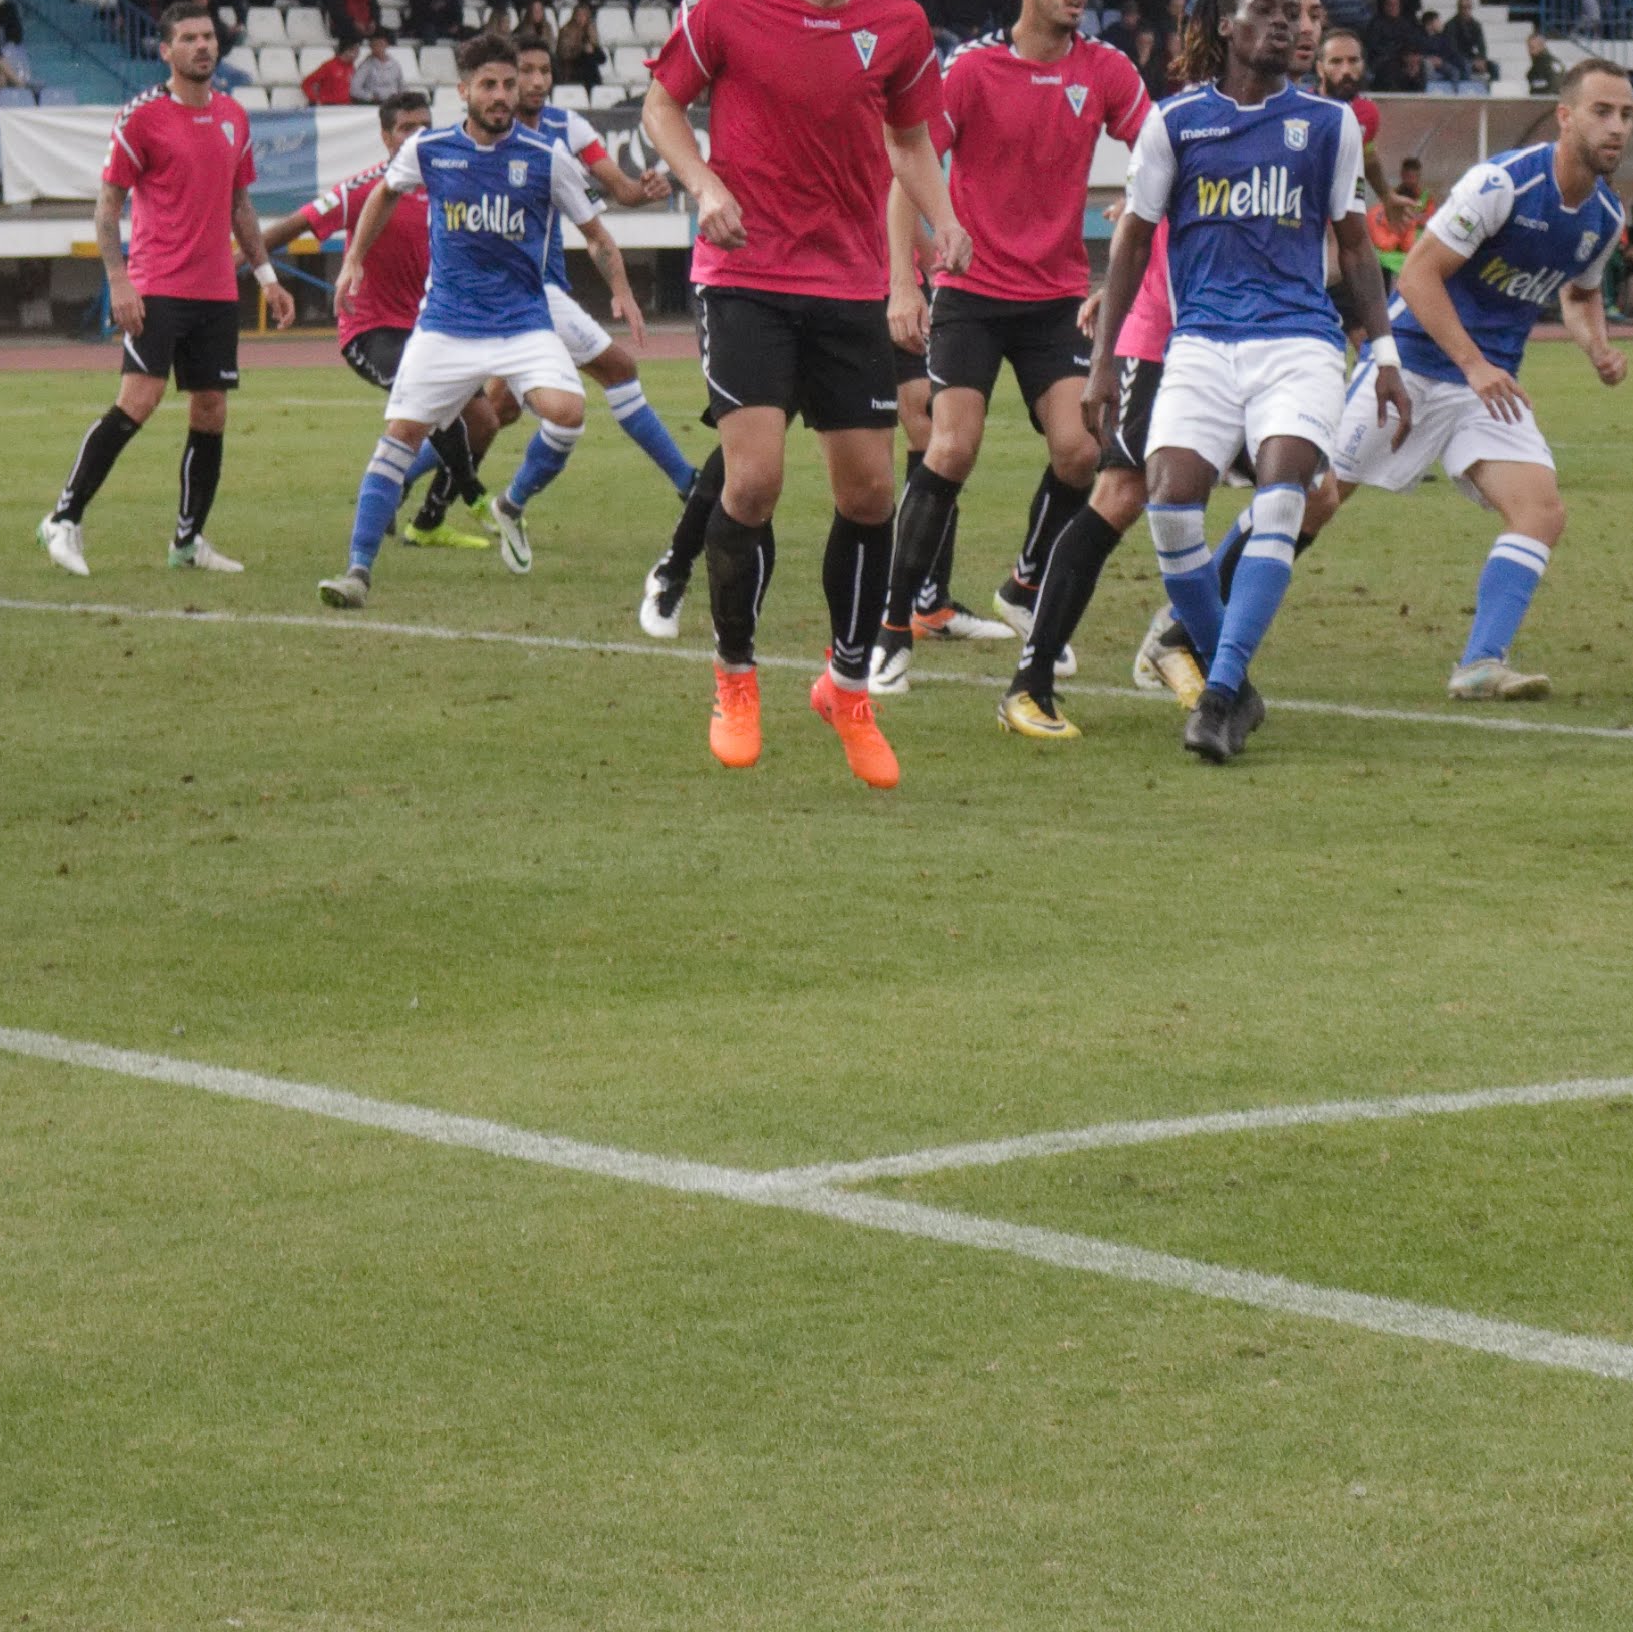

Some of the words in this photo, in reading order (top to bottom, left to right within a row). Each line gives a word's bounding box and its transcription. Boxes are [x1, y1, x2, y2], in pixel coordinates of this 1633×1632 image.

[1180, 126, 1231, 142] macron
[1197, 166, 1304, 219] melilla
[442, 193, 527, 234] melilla
